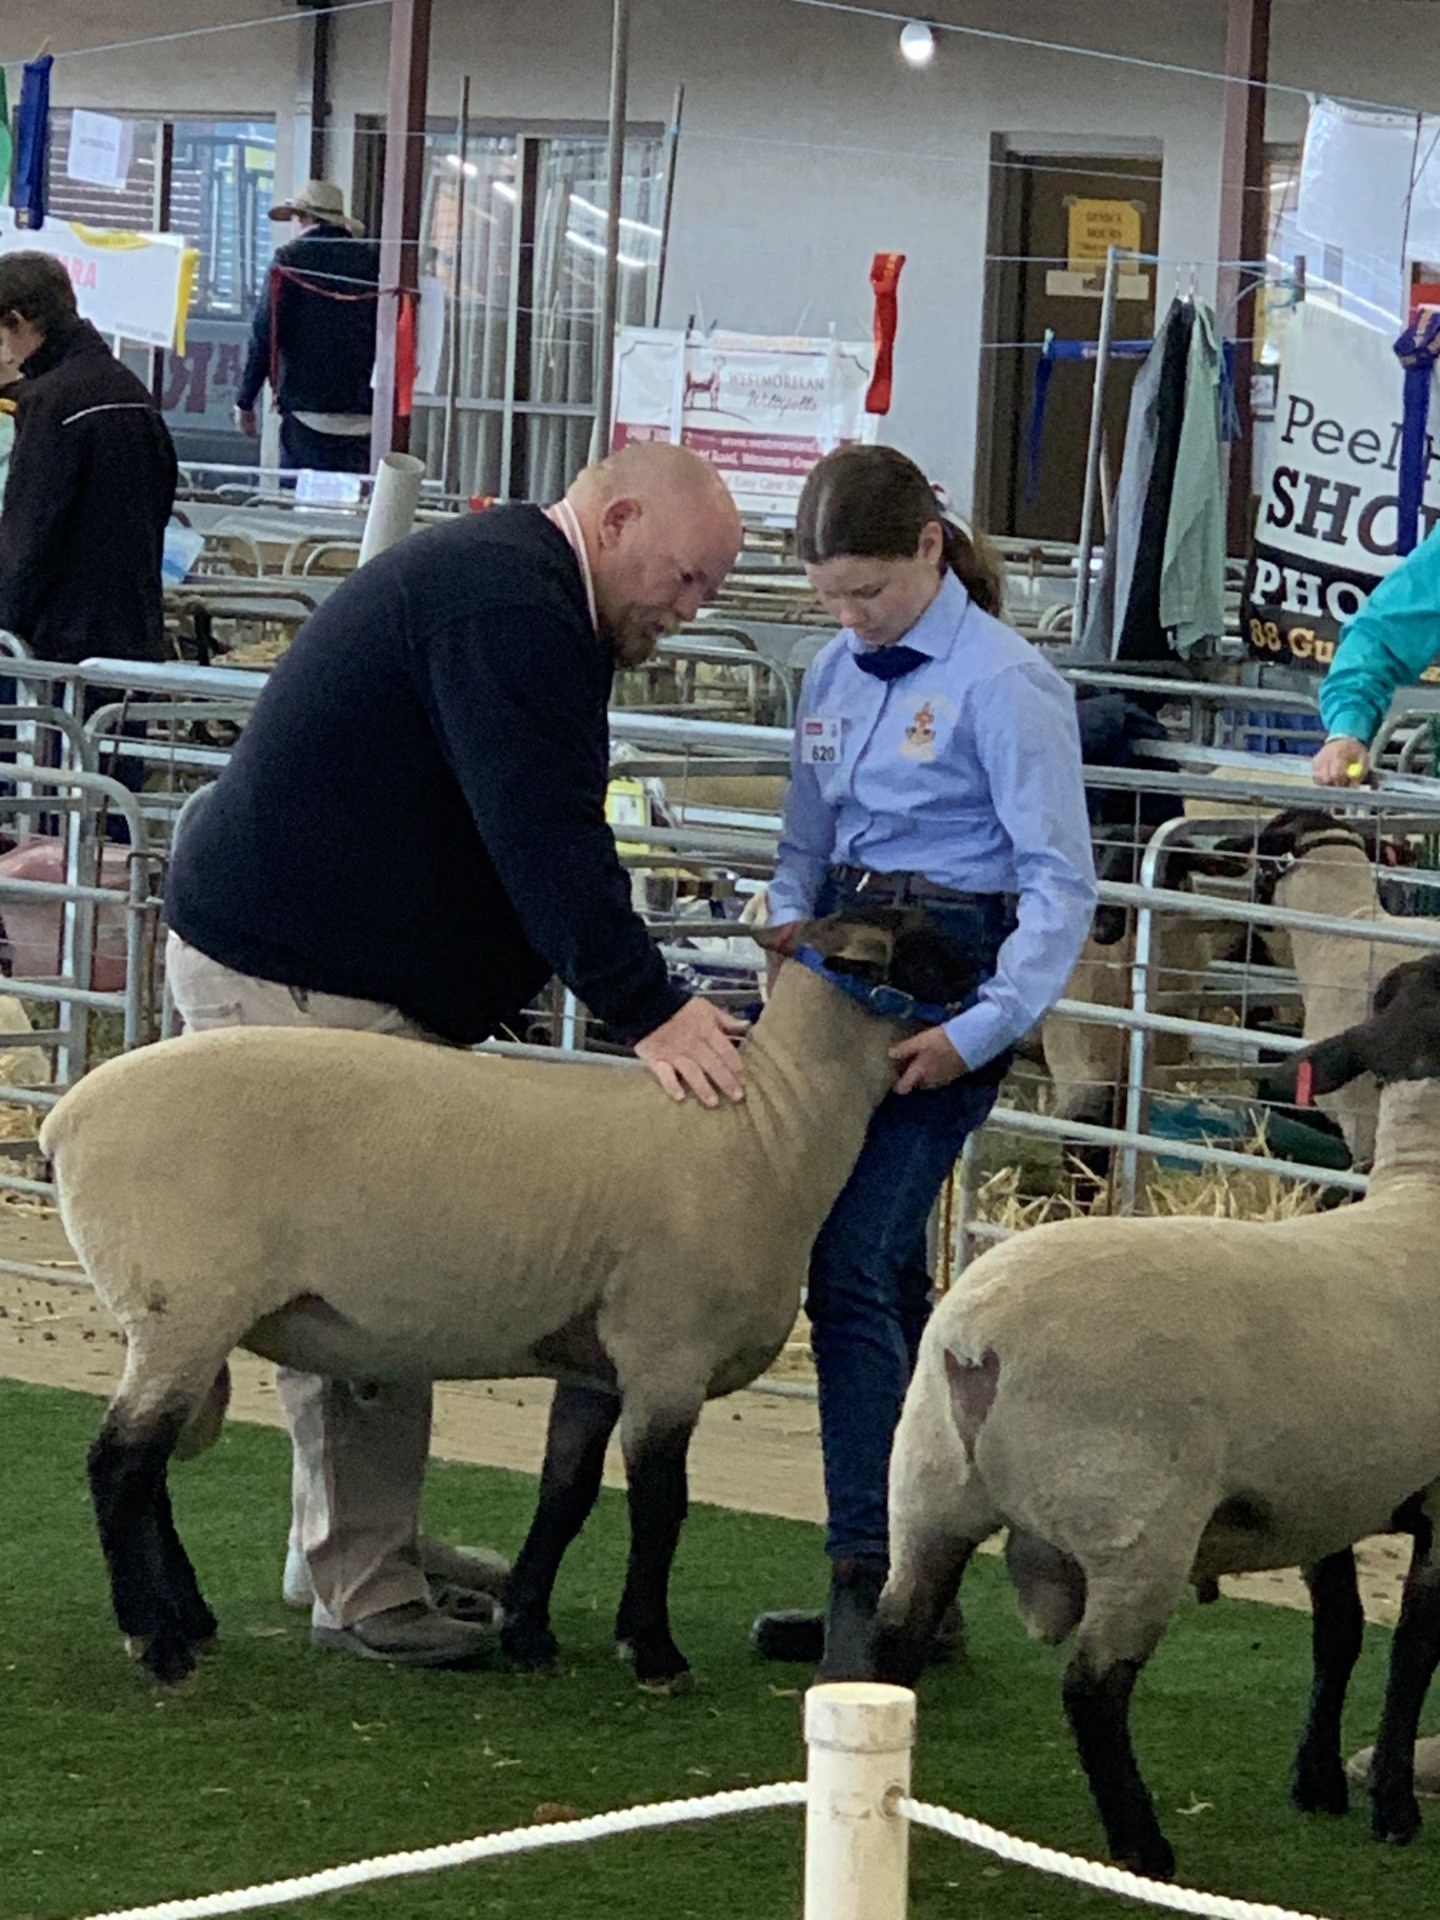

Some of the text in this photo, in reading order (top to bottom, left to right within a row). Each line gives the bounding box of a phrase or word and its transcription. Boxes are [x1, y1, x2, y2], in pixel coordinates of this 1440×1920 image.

[728, 370, 826, 391] WESTMORELAN
[1280, 394, 1404, 471] Peel
[1266, 465, 1440, 556] SHO
[1249, 557, 1368, 623] PHO
[1250, 617, 1335, 664] 88 Gu
[812, 745, 836, 762] 620
